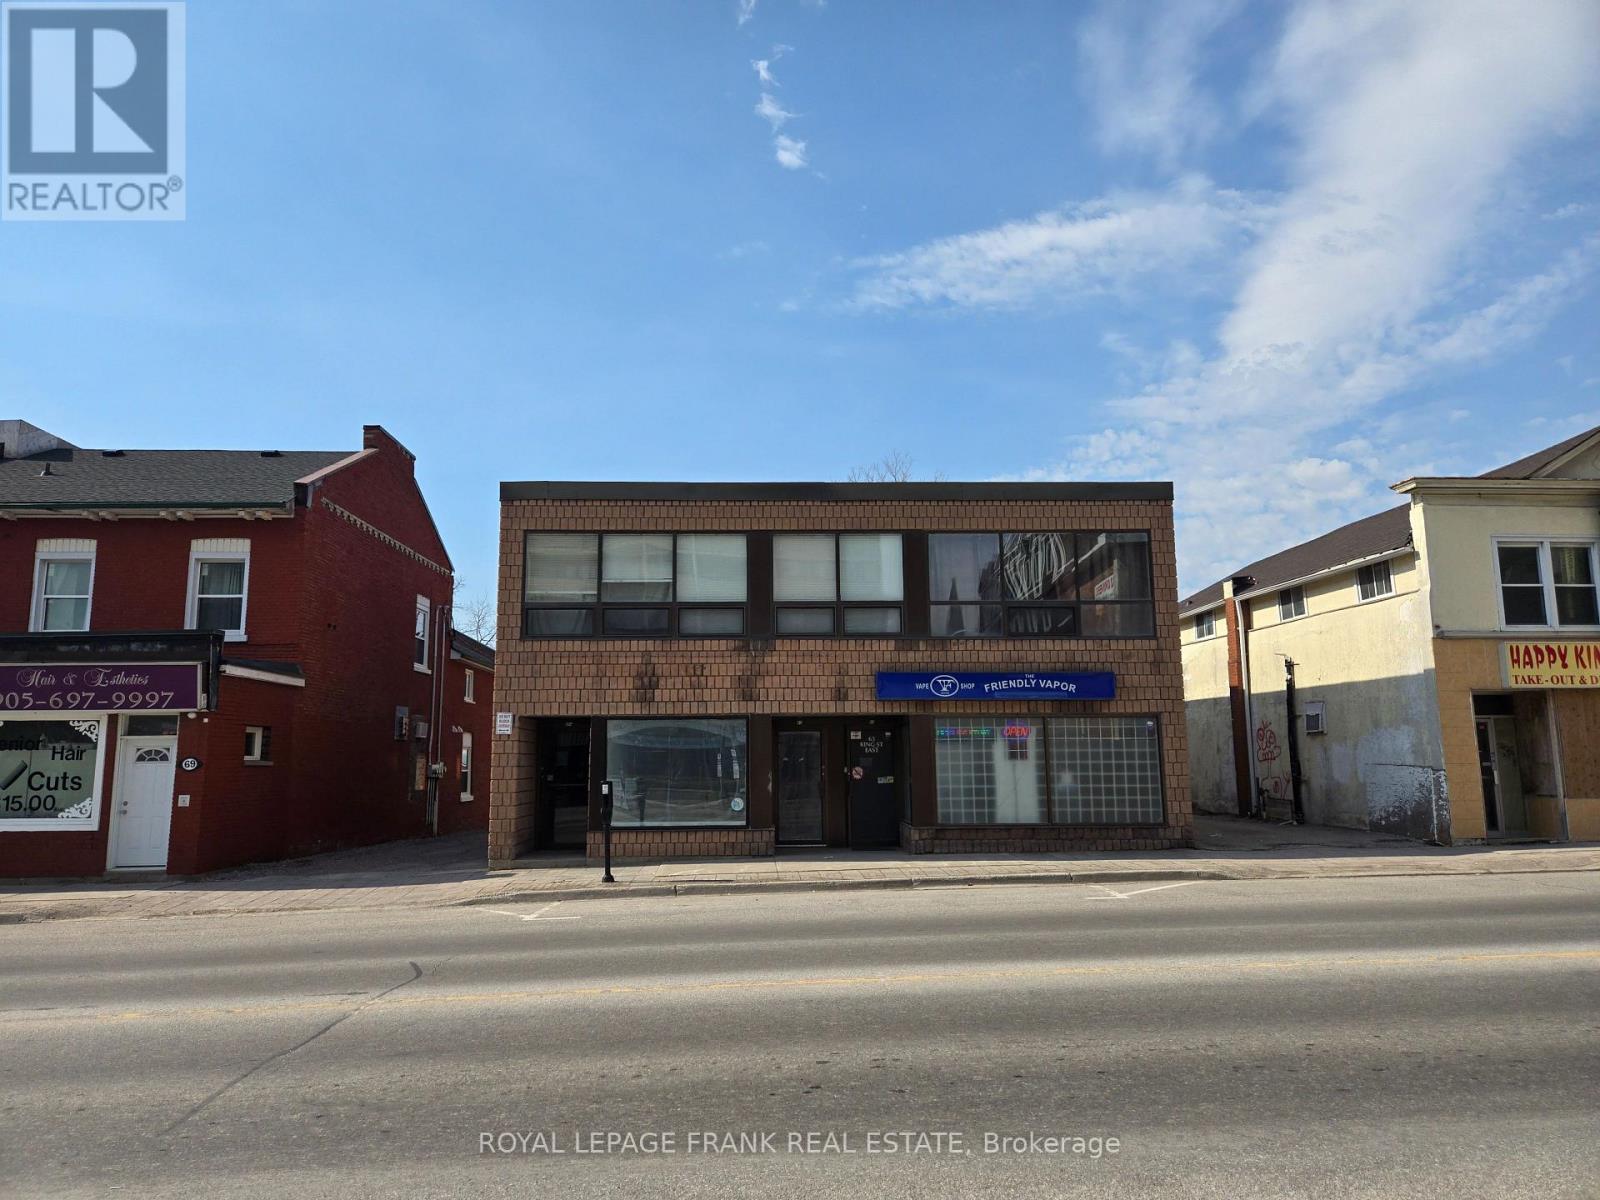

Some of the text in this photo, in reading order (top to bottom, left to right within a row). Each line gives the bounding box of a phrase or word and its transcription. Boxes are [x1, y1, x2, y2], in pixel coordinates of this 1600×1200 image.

[1510, 645, 1568, 669] HAPPY
[17, 668, 149, 687] Hair & Esthetics
[1579, 675, 1588, 685] &
[960, 682, 975, 690] SHOP
[984, 679, 1076, 693] FRIENDLY VAPOR
[1004, 727, 1031, 737] OPEN
[51, 745, 86, 760] Hair
[184, 760, 196, 768] 69
[28, 771, 82, 791] Cuts
